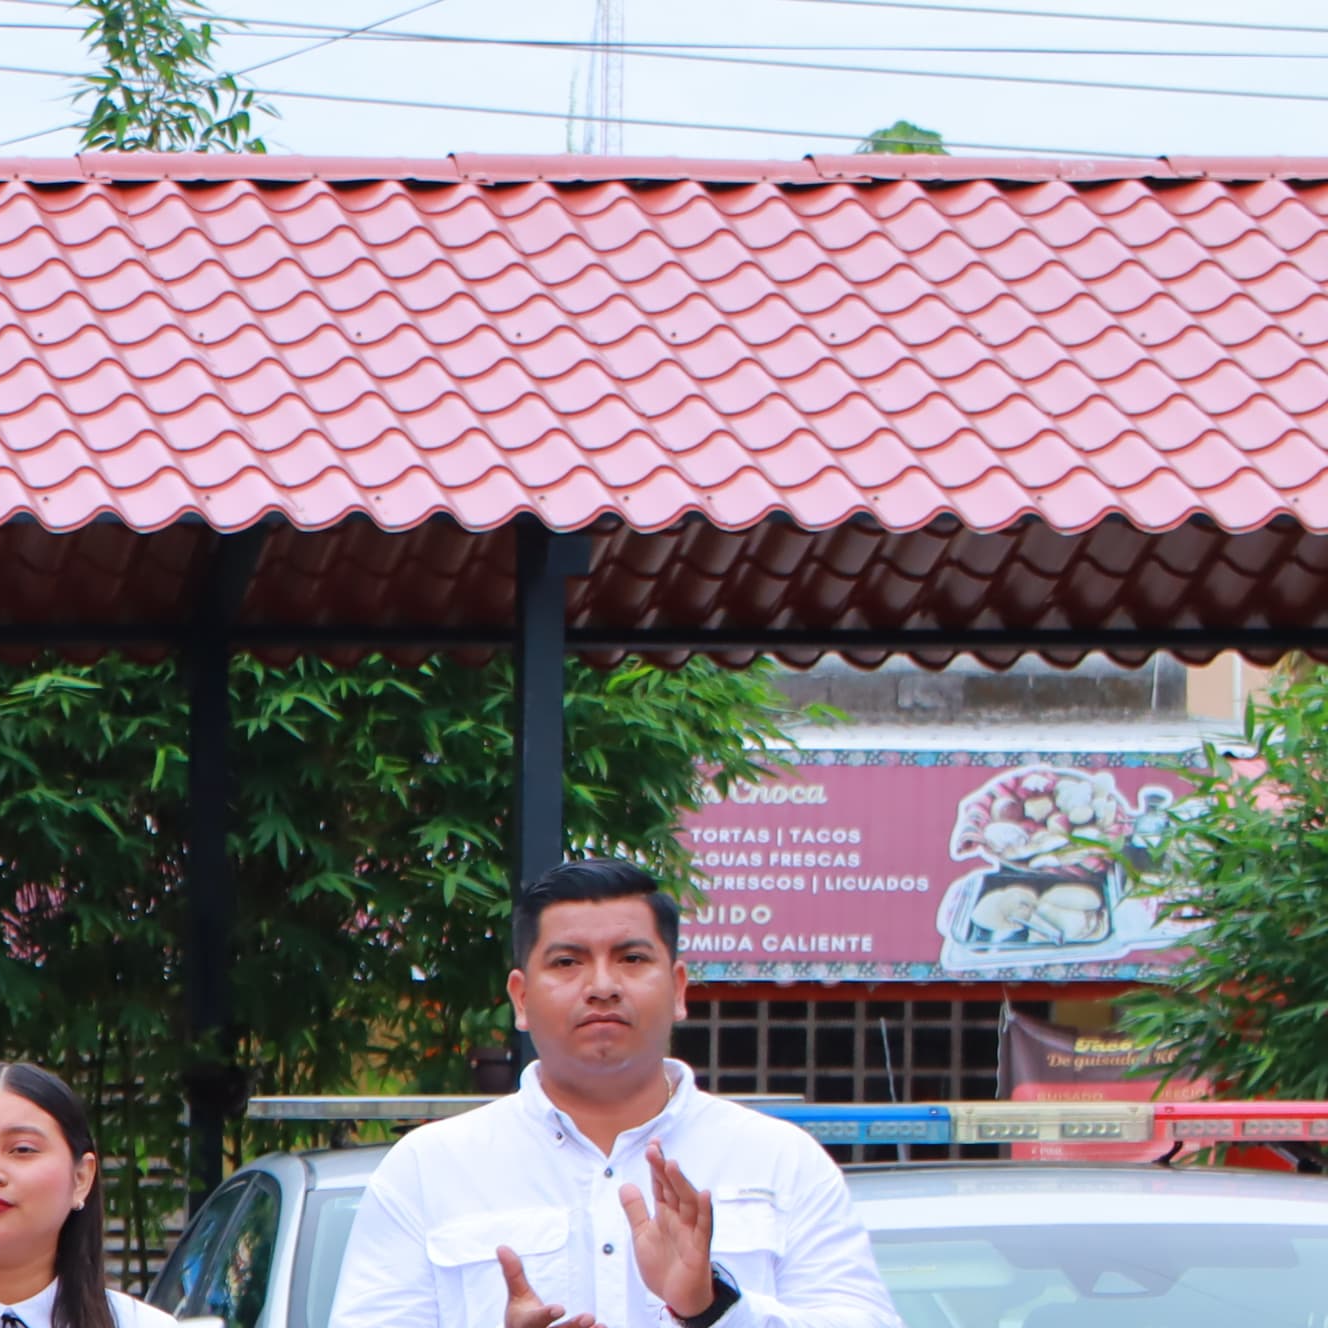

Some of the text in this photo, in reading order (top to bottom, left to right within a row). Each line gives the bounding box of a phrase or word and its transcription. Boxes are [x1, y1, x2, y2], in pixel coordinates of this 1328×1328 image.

[690, 828, 770, 844] TORTAS
[789, 828, 862, 845] TACOS
[690, 852, 861, 869] AGUAS FRESCAS
[825, 876, 930, 892] LICUADOS
[762, 934, 873, 952] CALIENTE
